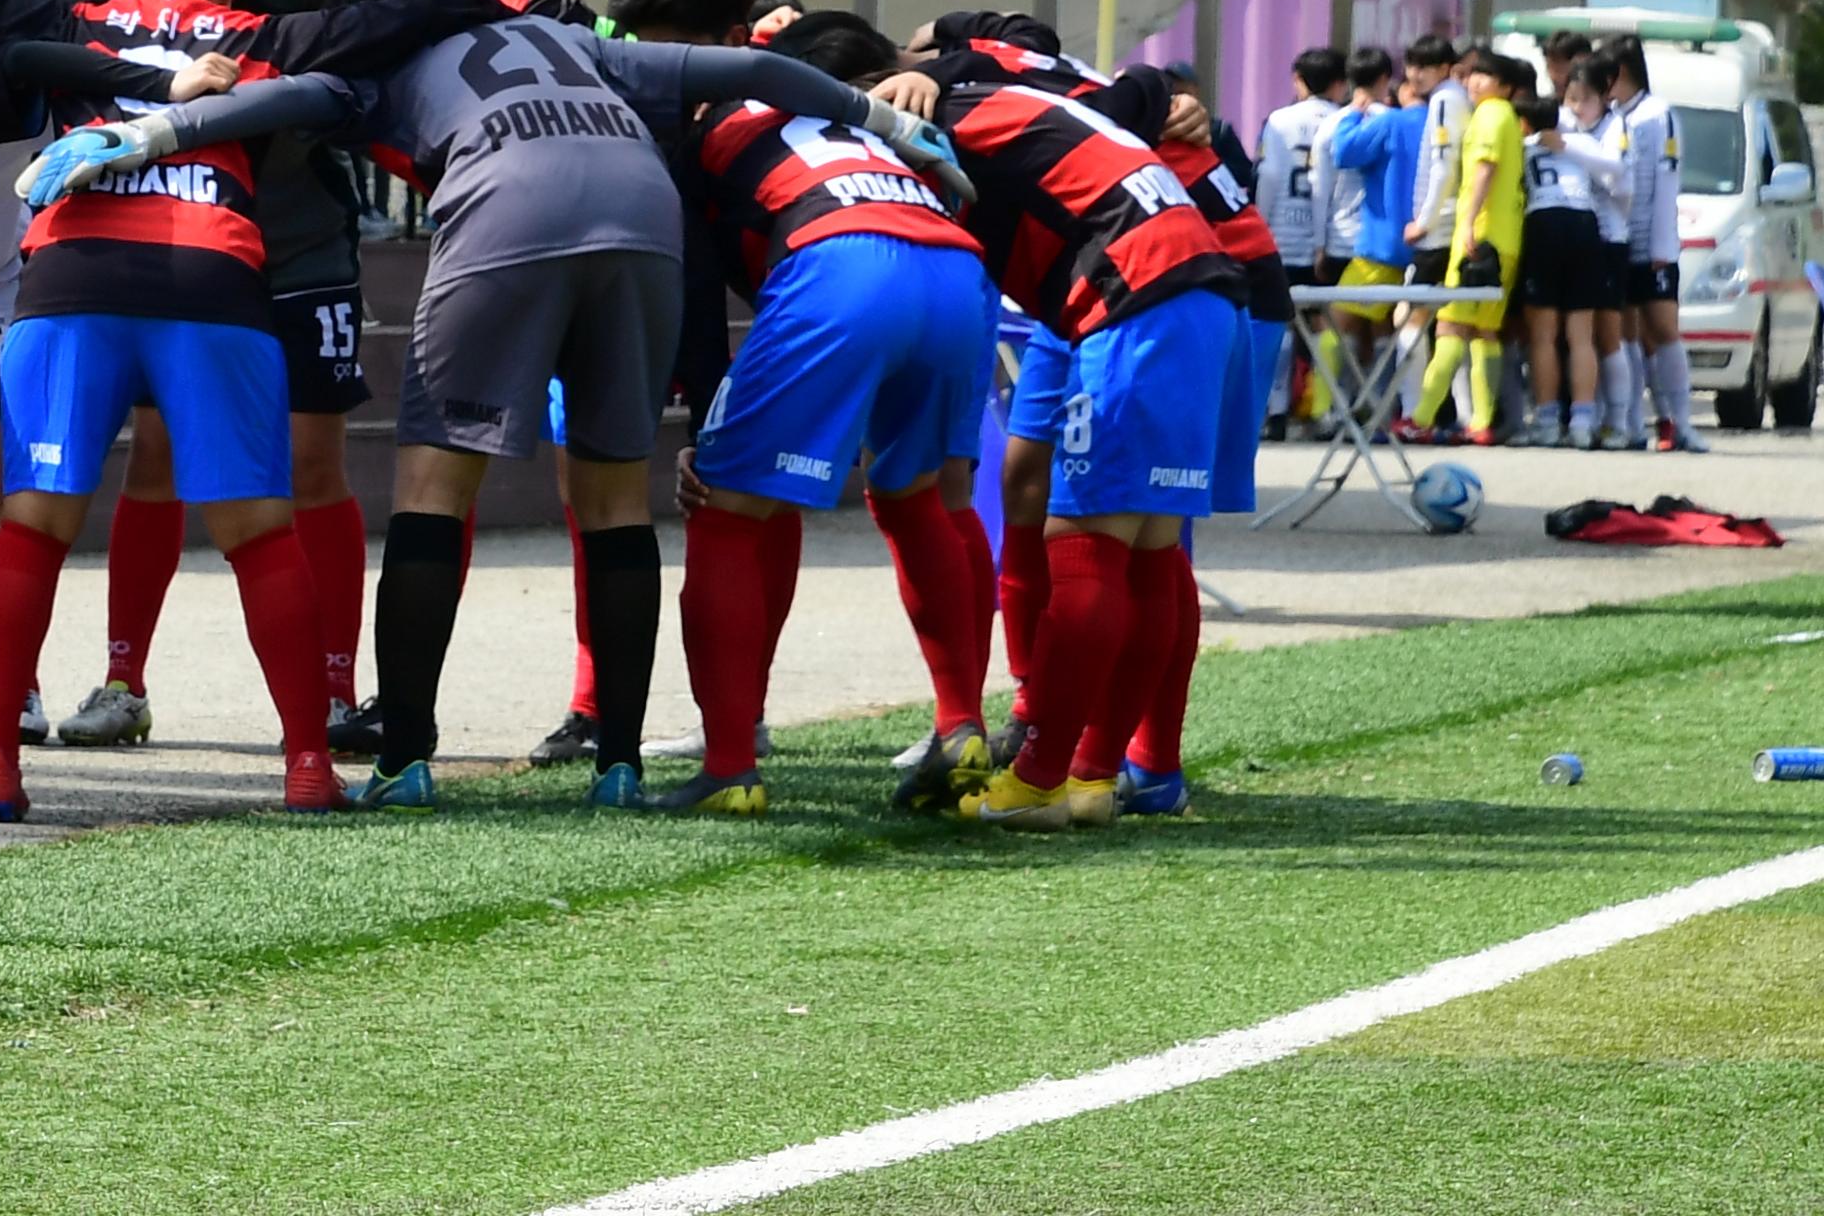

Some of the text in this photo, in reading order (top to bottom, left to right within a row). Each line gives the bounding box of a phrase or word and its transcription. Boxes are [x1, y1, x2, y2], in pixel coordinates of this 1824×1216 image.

[458, 21, 604, 102] 21
[480, 98, 641, 153] POHANG
[314, 301, 355, 358] 15
[1063, 392, 1093, 455] 8
[776, 451, 833, 482] POHANG
[1148, 466, 1209, 490] POHANG
